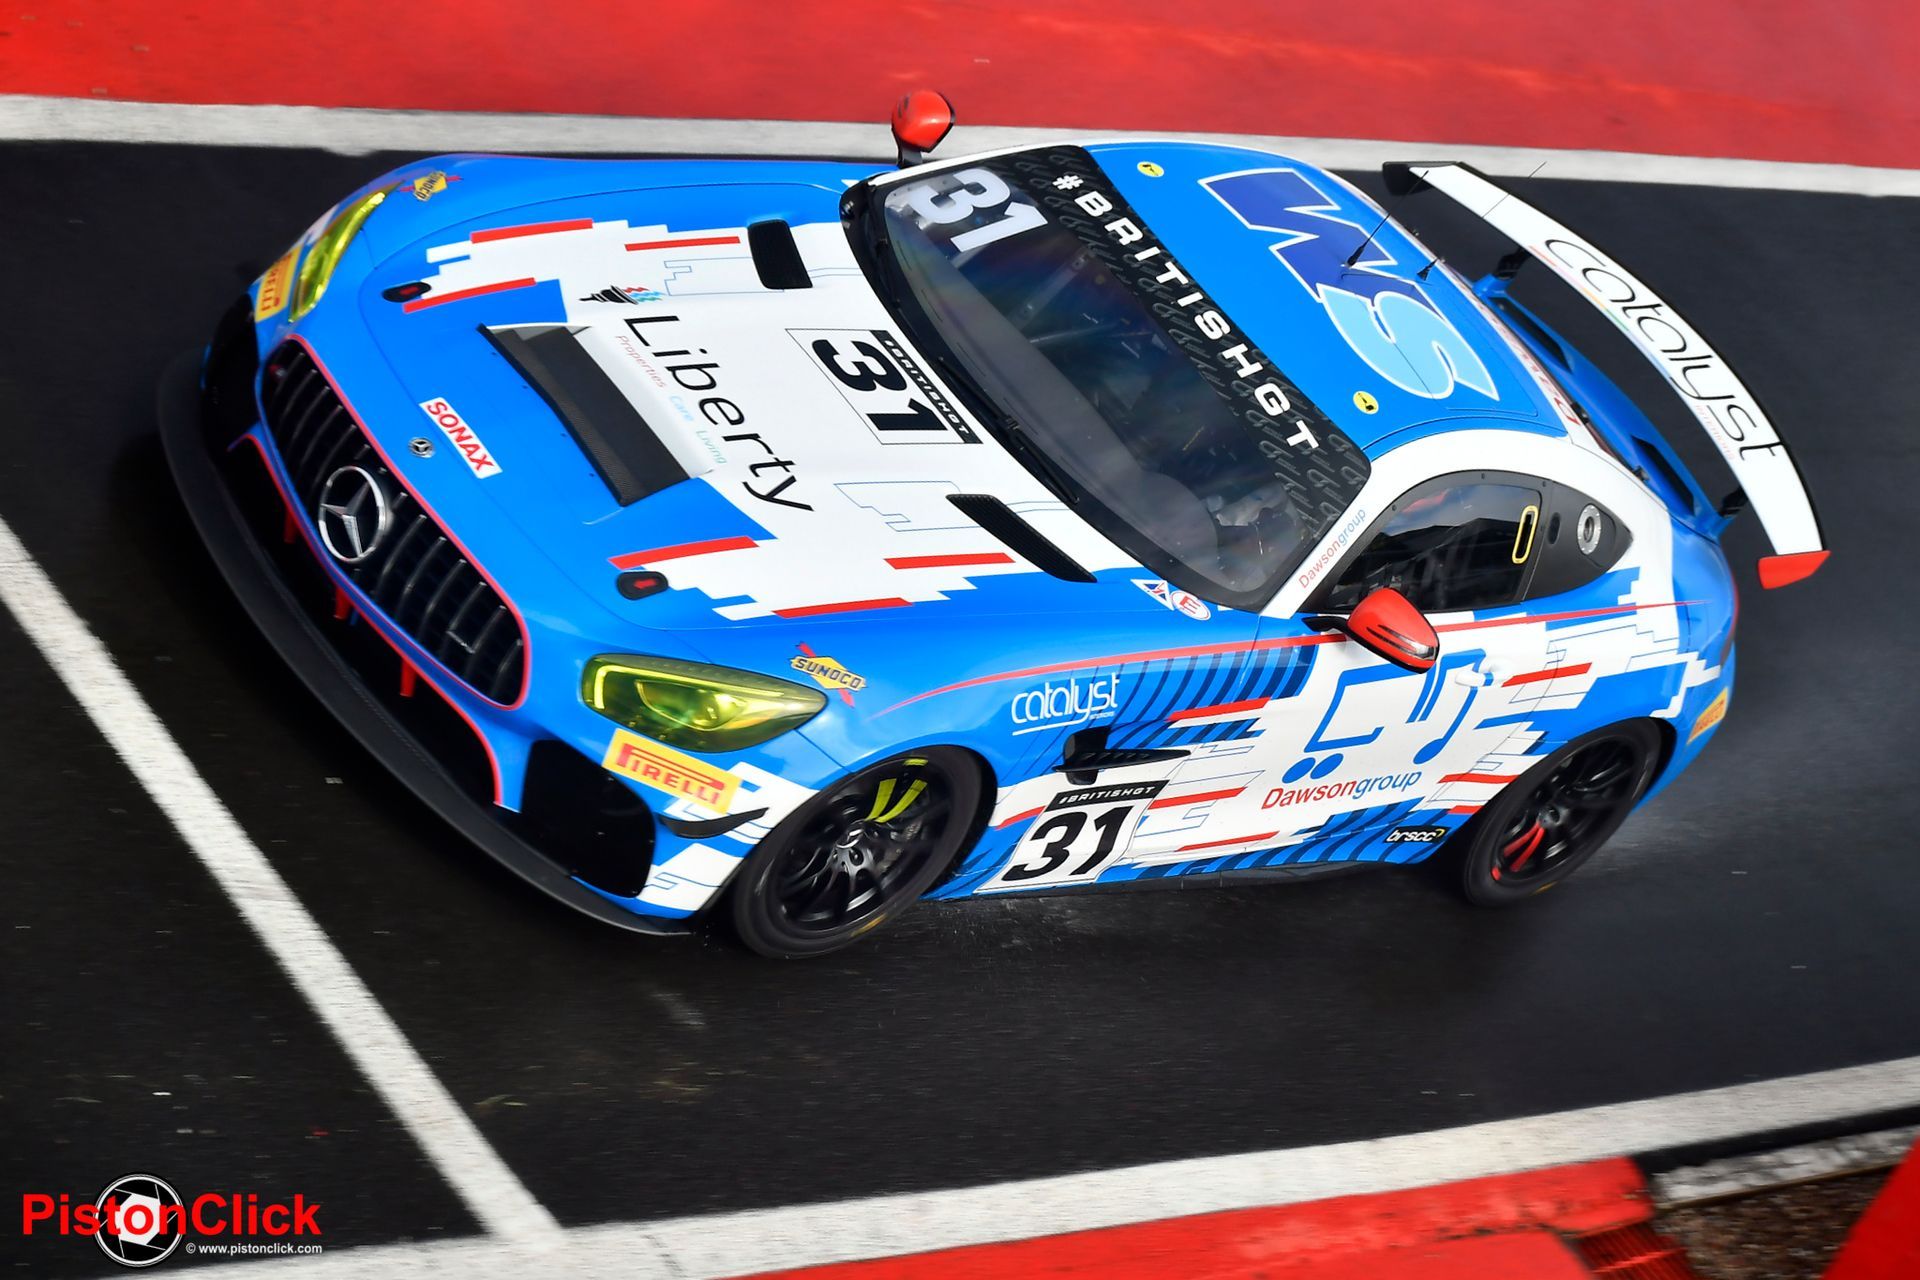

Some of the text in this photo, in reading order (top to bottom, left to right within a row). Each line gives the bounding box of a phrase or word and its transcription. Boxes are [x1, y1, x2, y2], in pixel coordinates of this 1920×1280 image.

[905, 168, 1048, 252] 31
[1052, 174, 1319, 449] #BRITISHGT
[1545, 239, 1783, 460] catalyst
[615, 335, 727, 463] Properties Care Living
[624, 316, 814, 511] Liberty
[812, 339, 948, 430] 31
[427, 401, 494, 471] SONAX
[1298, 508, 1366, 589] Dawsongroup
[795, 658, 863, 690] SUNOCO
[1012, 672, 1120, 735] catalyst
[616, 742, 726, 805] PIRELLI
[1261, 771, 1422, 810] Dawsongroup
[1001, 805, 1135, 881] 31
